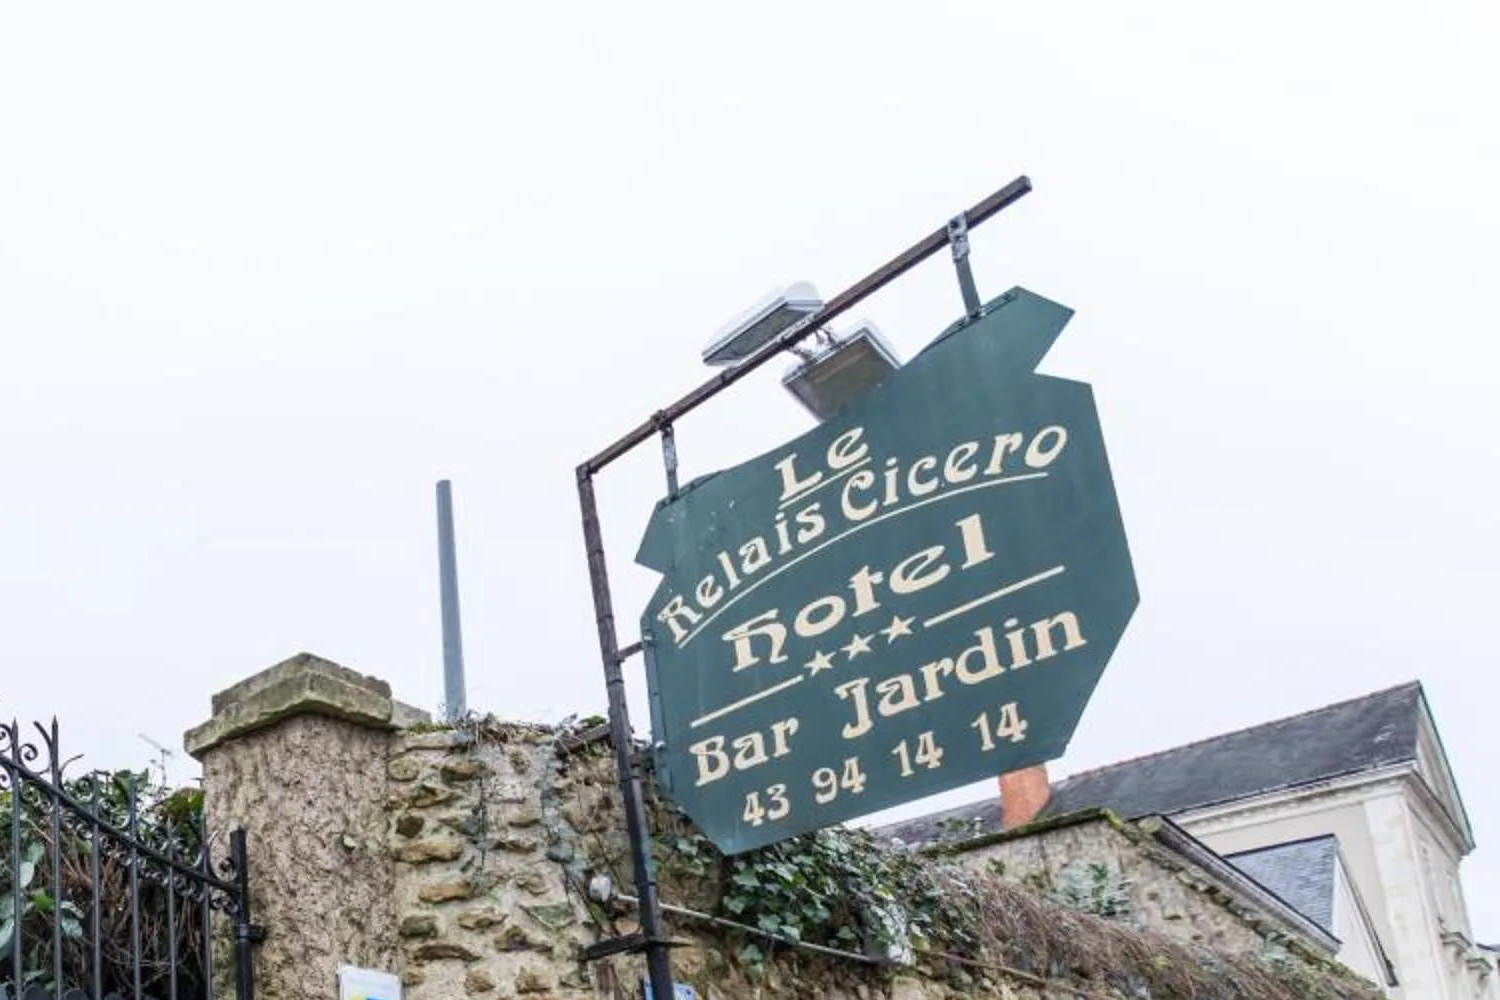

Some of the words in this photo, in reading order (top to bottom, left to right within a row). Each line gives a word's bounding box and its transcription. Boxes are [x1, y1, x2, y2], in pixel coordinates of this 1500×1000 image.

[656, 502, 827, 645] Relais
[841, 425, 1068, 522] Cicero
[773, 427, 869, 502] Le
[688, 715, 800, 788] Bar
[834, 608, 1089, 740] Jardin
[742, 782, 791, 828] 43
[812, 756, 867, 805] 94
[891, 731, 944, 778] 14
[971, 701, 1029, 754] 14
